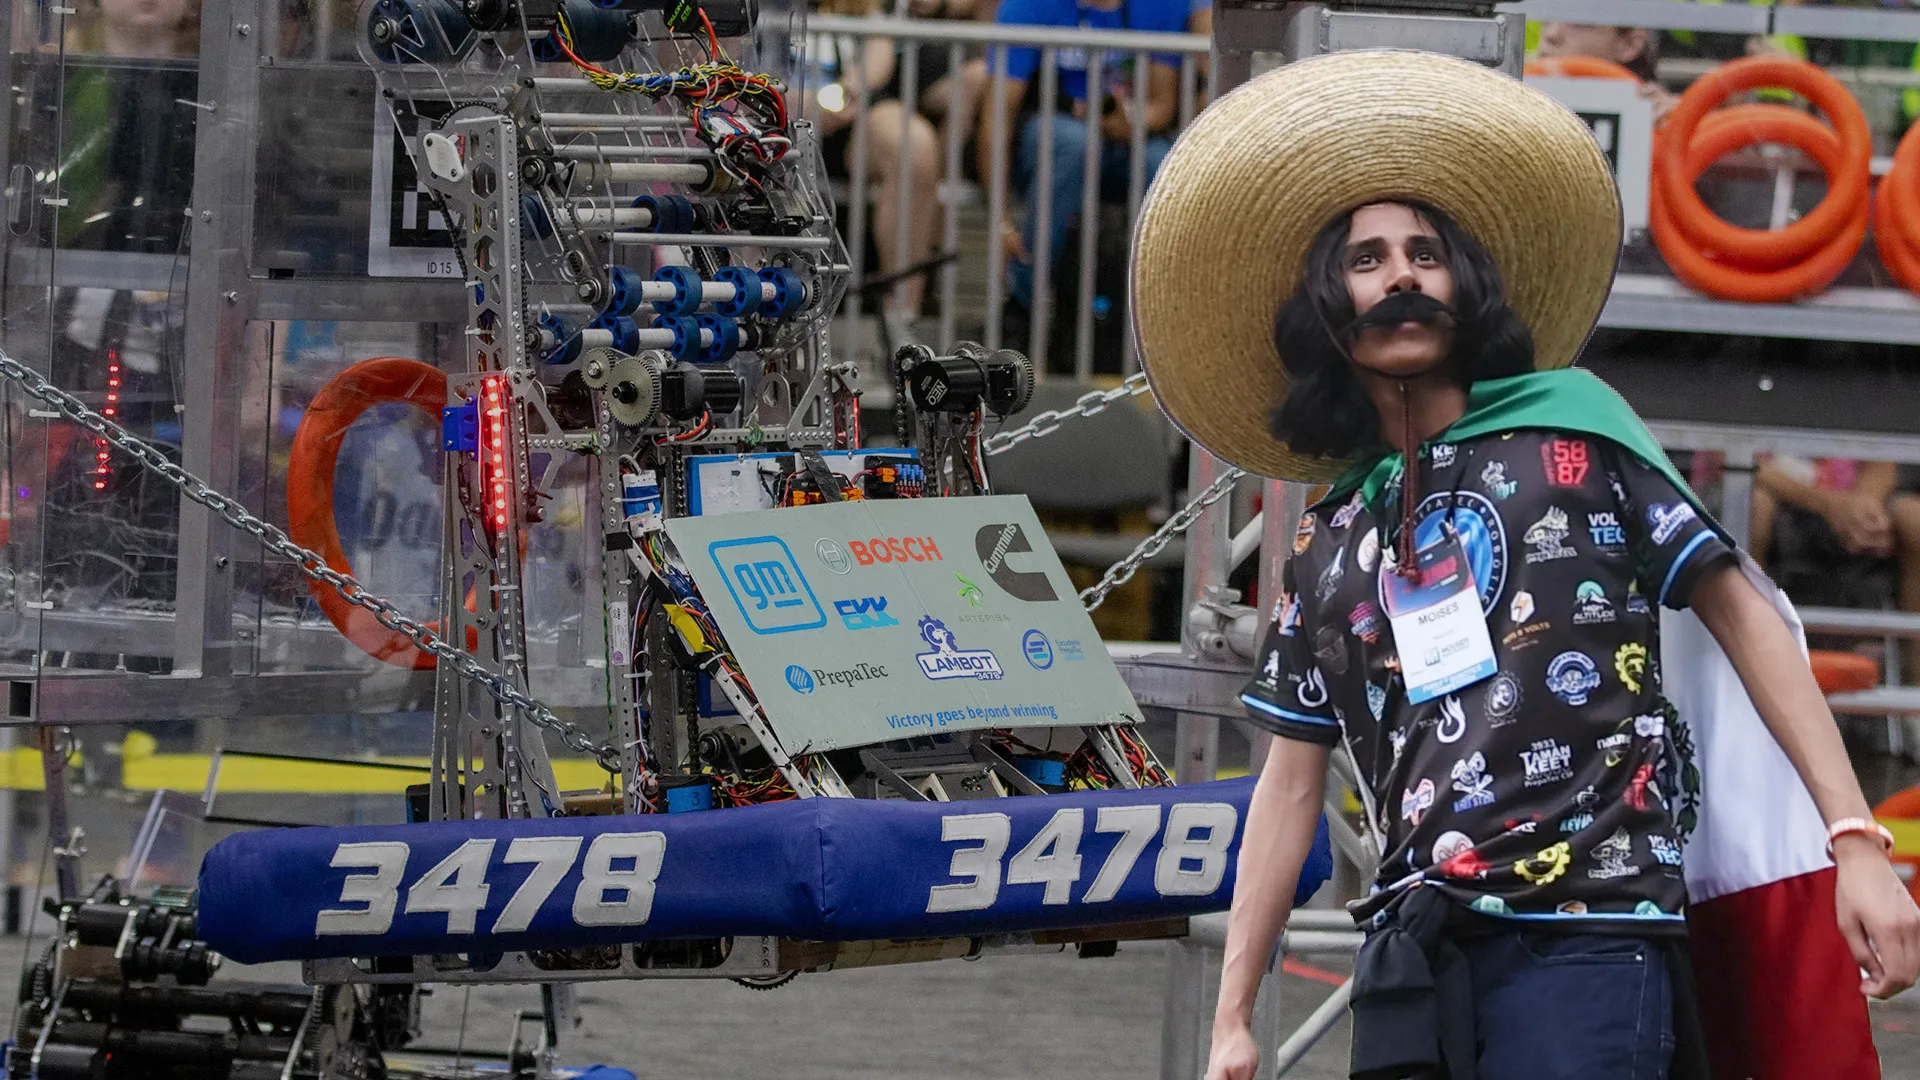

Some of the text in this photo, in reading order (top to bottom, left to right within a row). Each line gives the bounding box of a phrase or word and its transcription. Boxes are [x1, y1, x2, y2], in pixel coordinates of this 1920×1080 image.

[427, 262, 452, 274] ID 15
[927, 380, 947, 406] NEO
[1553, 440, 1587, 462] 58
[1557, 462, 1590, 485] 87
[848, 536, 943, 566] BOSCH
[983, 523, 1018, 575] Cummins
[734, 561, 797, 611] gm
[1418, 602, 1460, 626] MOISES
[812, 662, 889, 688] PrepaTec
[922, 656, 994, 673] LAMBOT
[975, 671, 1001, 681] 3478
[885, 703, 1058, 729] Victory goes beyond winning
[1524, 757, 1571, 777] KEET
[691, 791, 701, 807] 3
[925, 803, 1237, 913] 3478
[316, 832, 667, 936] 3478
